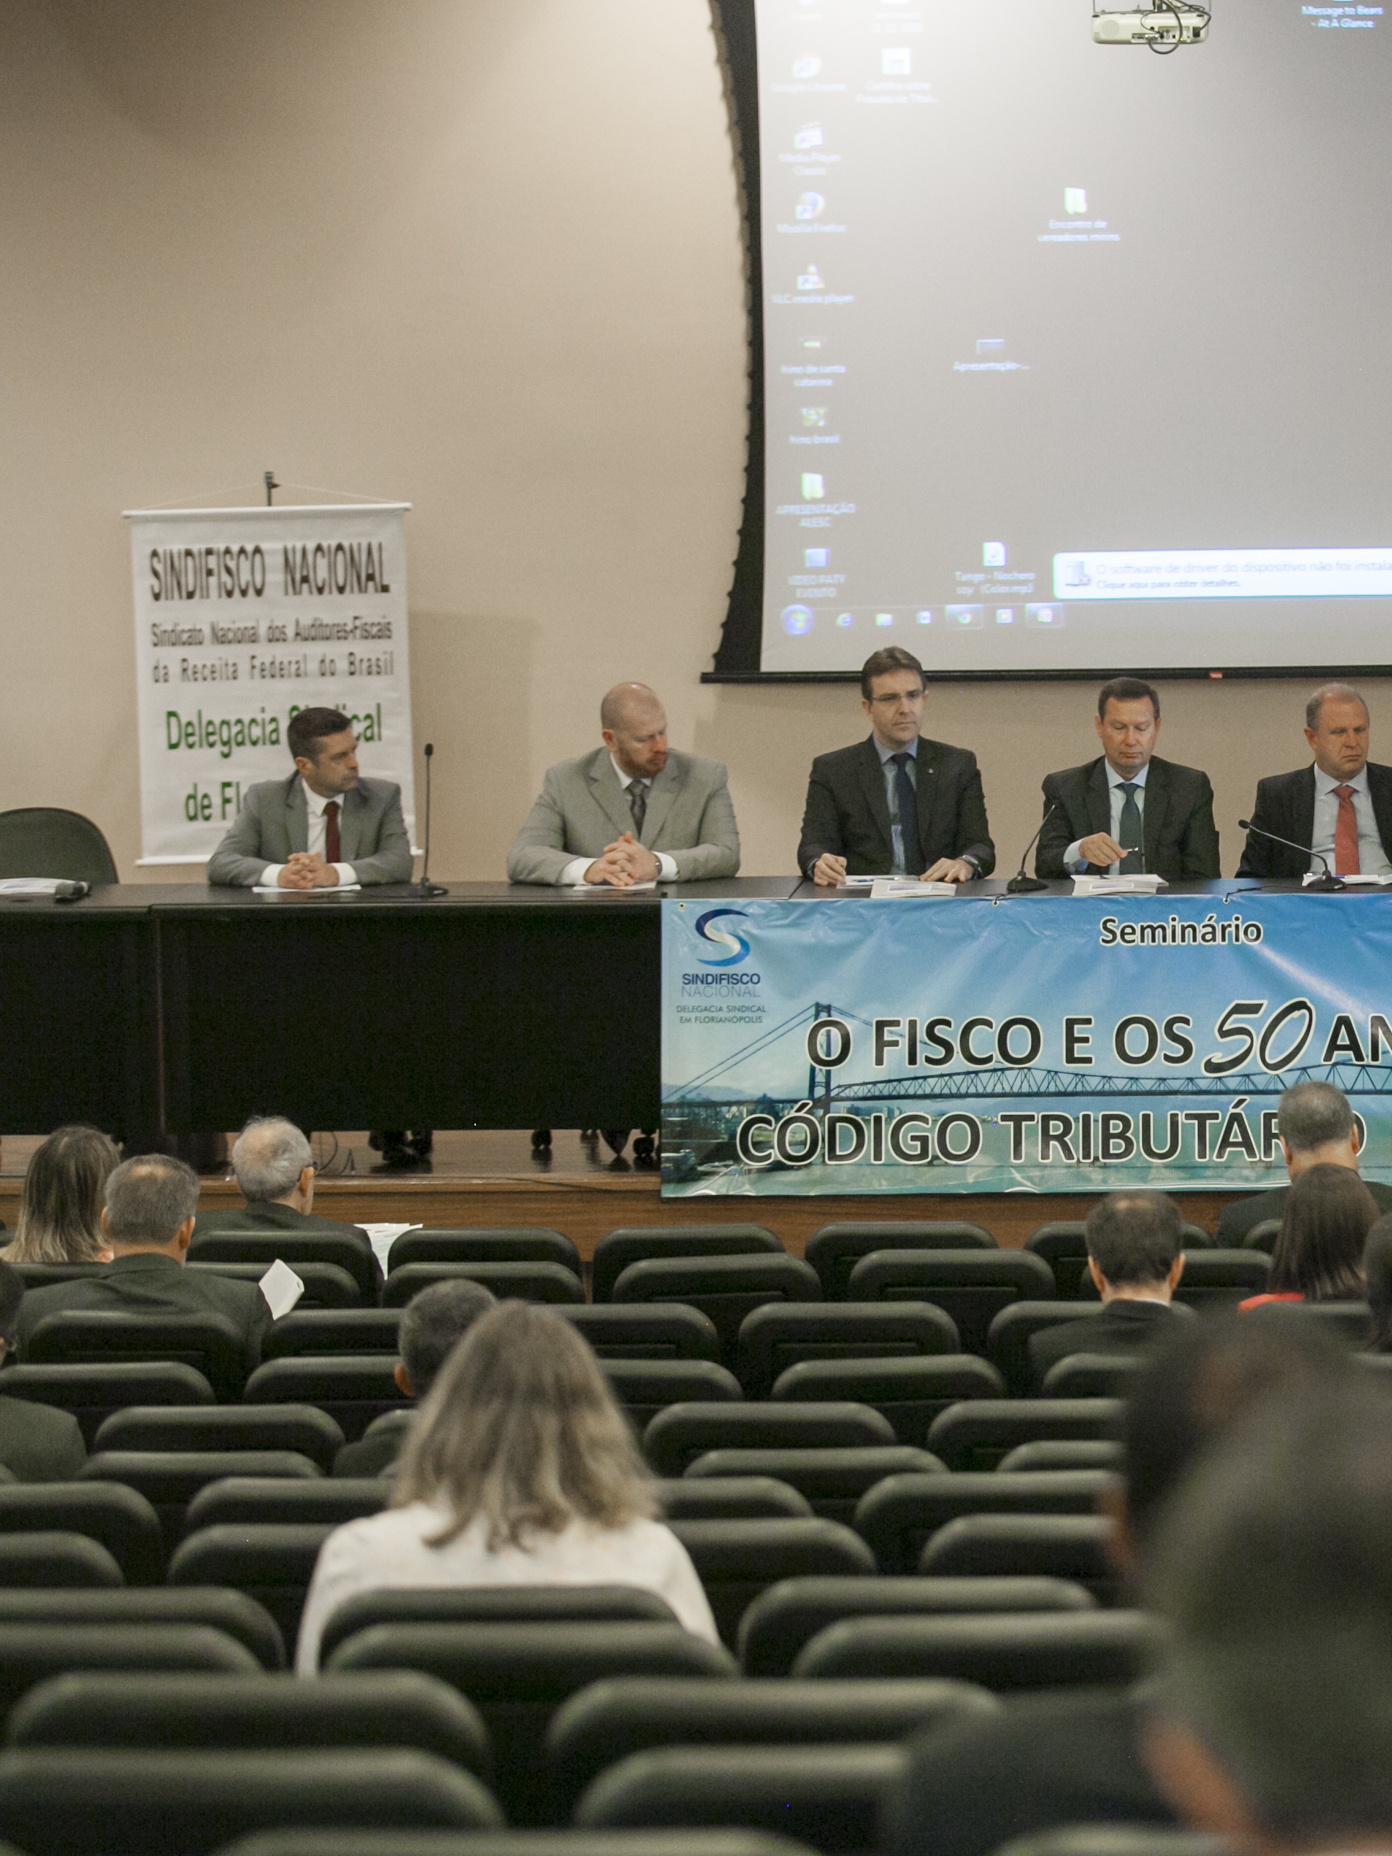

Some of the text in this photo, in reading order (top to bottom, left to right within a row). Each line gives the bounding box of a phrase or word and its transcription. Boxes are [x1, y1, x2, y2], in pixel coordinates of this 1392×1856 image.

[150, 541, 391, 601] SINDIFISCO NACIONAL
[151, 615, 393, 647] Sindicato Nacional dos Auditores-Fiscais
[153, 650, 394, 683] da Receita Federal do Brasil
[166, 707, 281, 759] Delegacia
[185, 783, 212, 822] de
[1100, 915, 1263, 946] Seminário
[681, 985, 761, 998] NACIONAL
[682, 973, 761, 985] SINDIFISCO
[676, 1005, 766, 1013] DELEGACIA SINDICAL
[694, 1015, 763, 1023] FLORIANÓPOLIS
[806, 1016, 852, 1069] O
[873, 1016, 1042, 1068] FISCO
[1063, 1016, 1095, 1066] E
[1113, 1014, 1195, 1067] OS
[1203, 997, 1315, 1077] 50
[737, 1100, 983, 1166] CÓDIGO
